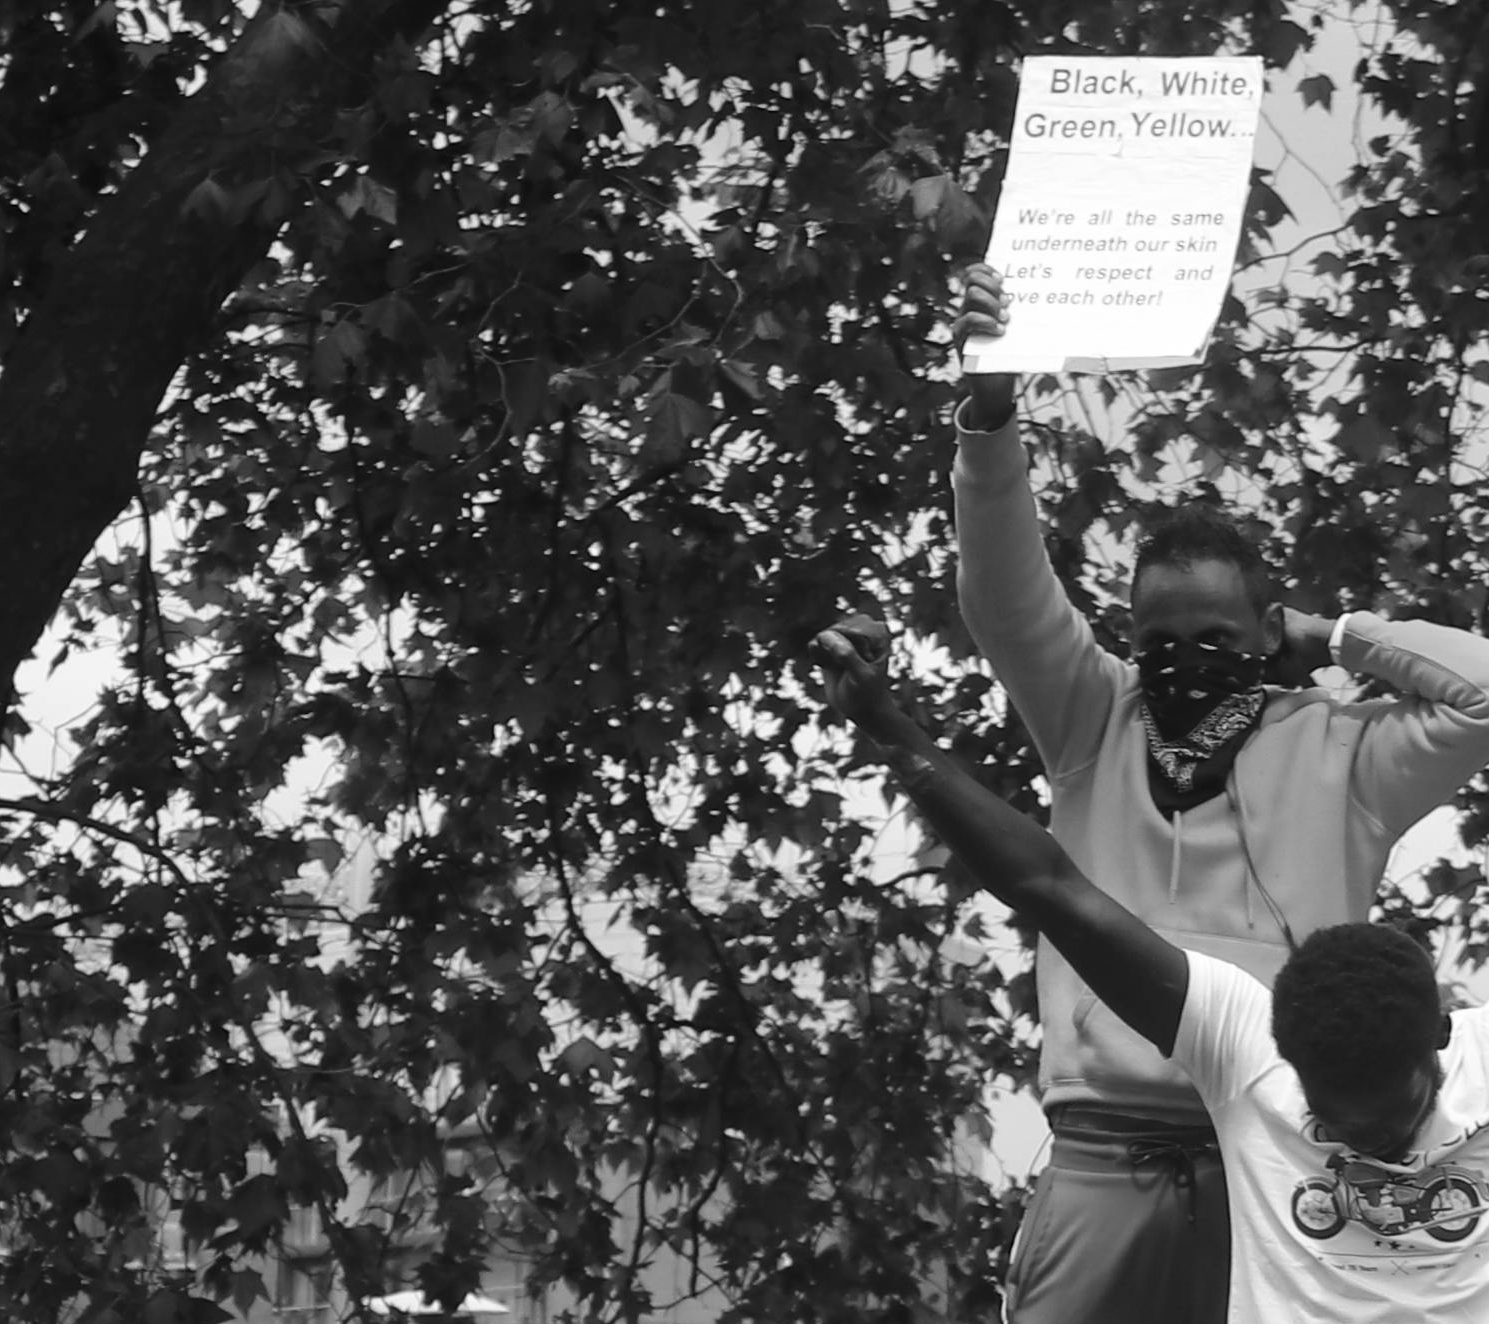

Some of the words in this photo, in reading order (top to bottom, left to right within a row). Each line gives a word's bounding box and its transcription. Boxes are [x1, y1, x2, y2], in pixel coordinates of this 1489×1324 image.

[1050, 68, 1144, 99] Black,
[1161, 71, 1255, 99] White,
[1023, 112, 1123, 141] Green,
[1018, 208, 1075, 225] We're
[1087, 209, 1112, 225] all
[1125, 210, 1156, 226] the
[1170, 212, 1224, 226] same
[1011, 237, 1128, 251] underneath
[1135, 239, 1169, 251] our
[1176, 237, 1218, 252] skin
[1004, 263, 1052, 279] Let's
[1076, 265, 1154, 284] respect
[1174, 265, 1214, 280] and
[1006, 291, 1040, 304] ove
[1046, 289, 1094, 305] each
[1101, 289, 1163, 306] other!
